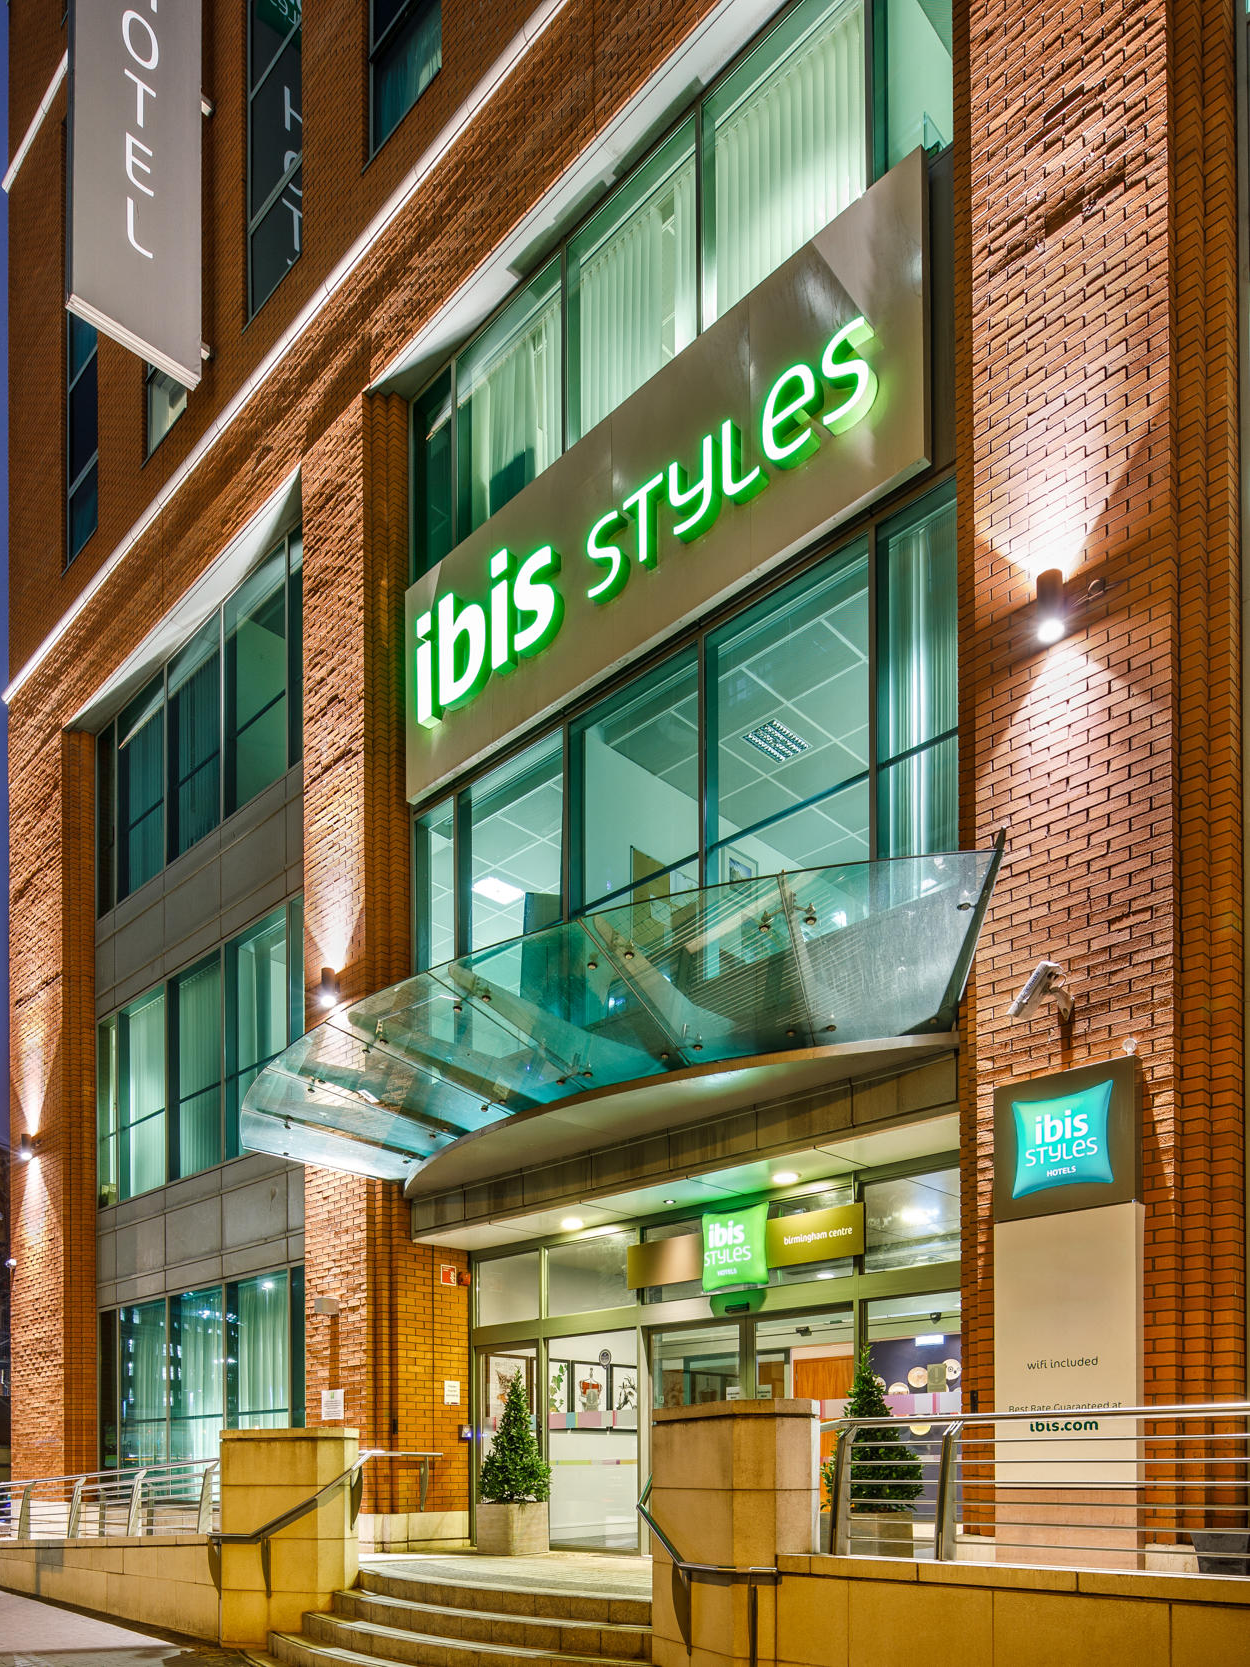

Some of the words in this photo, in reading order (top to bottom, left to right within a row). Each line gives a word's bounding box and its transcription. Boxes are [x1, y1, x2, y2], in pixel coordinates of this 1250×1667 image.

[122, 0, 158, 259] OTEL
[415, 545, 562, 729] ibis
[1035, 1109, 1088, 1145] ibis
[1046, 1165, 1077, 1177] HOTELS
[708, 1220, 745, 1248] ibis
[783, 1232, 827, 1245] birmingham
[829, 1226, 853, 1237] centre
[1027, 1359, 1048, 1370] wifi
[1050, 1356, 1099, 1369] included
[1053, 1401, 1110, 1411] Guaranteed
[1030, 1420, 1099, 1432] ibis.com
